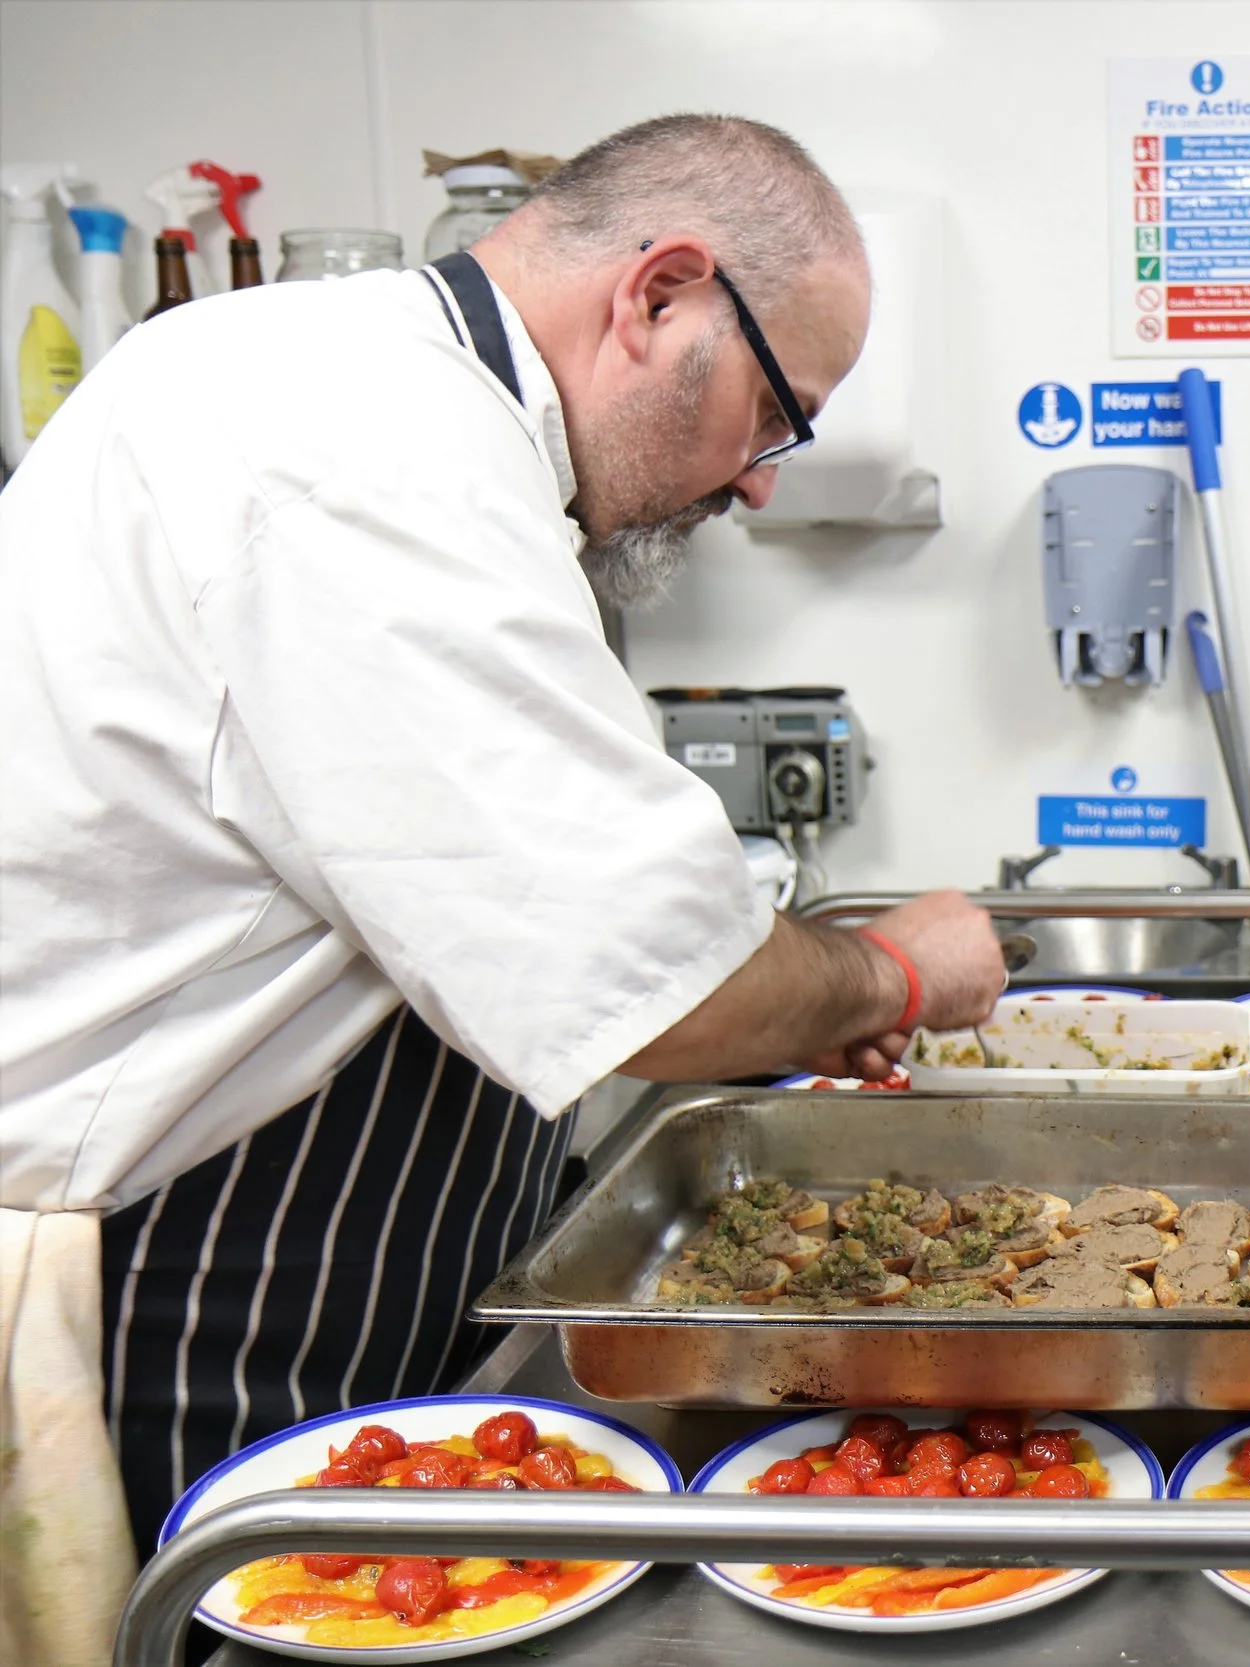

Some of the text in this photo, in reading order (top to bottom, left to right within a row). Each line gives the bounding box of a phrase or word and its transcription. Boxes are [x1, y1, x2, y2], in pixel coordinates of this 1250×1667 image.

[1146, 99, 1189, 117] Fire
[1101, 389, 1183, 411] Now wa
[1094, 416, 1189, 444] your han
[1075, 801, 1171, 820] This sink for
[1062, 821, 1182, 843] hand wash only
